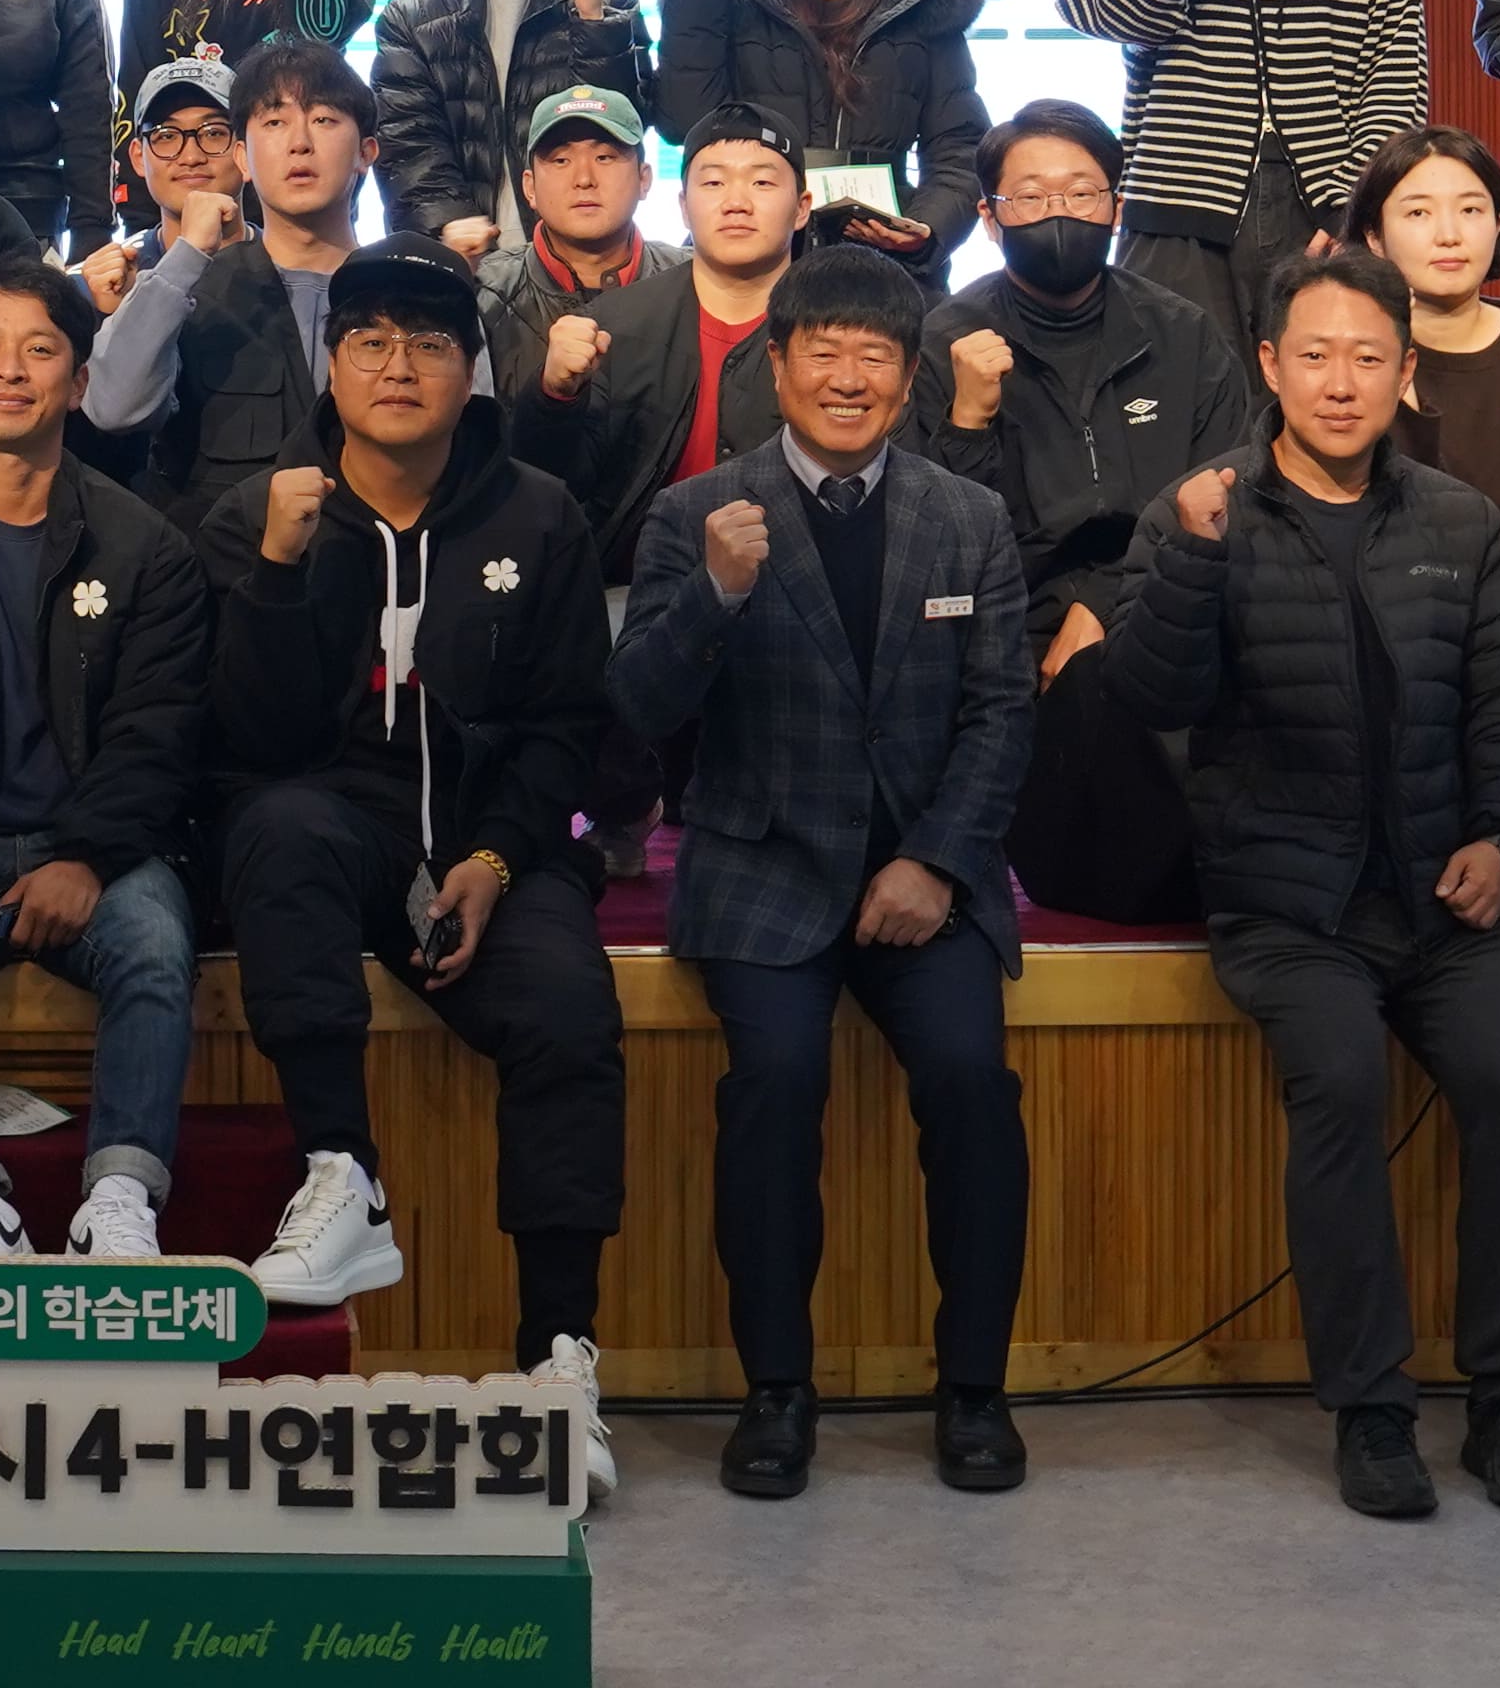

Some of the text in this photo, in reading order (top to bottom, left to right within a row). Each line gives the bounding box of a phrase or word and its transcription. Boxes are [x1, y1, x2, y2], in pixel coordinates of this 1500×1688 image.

[42, 1284, 238, 1344] 학습단체
[58, 1618, 551, 1663] Head Heart Hands Health
